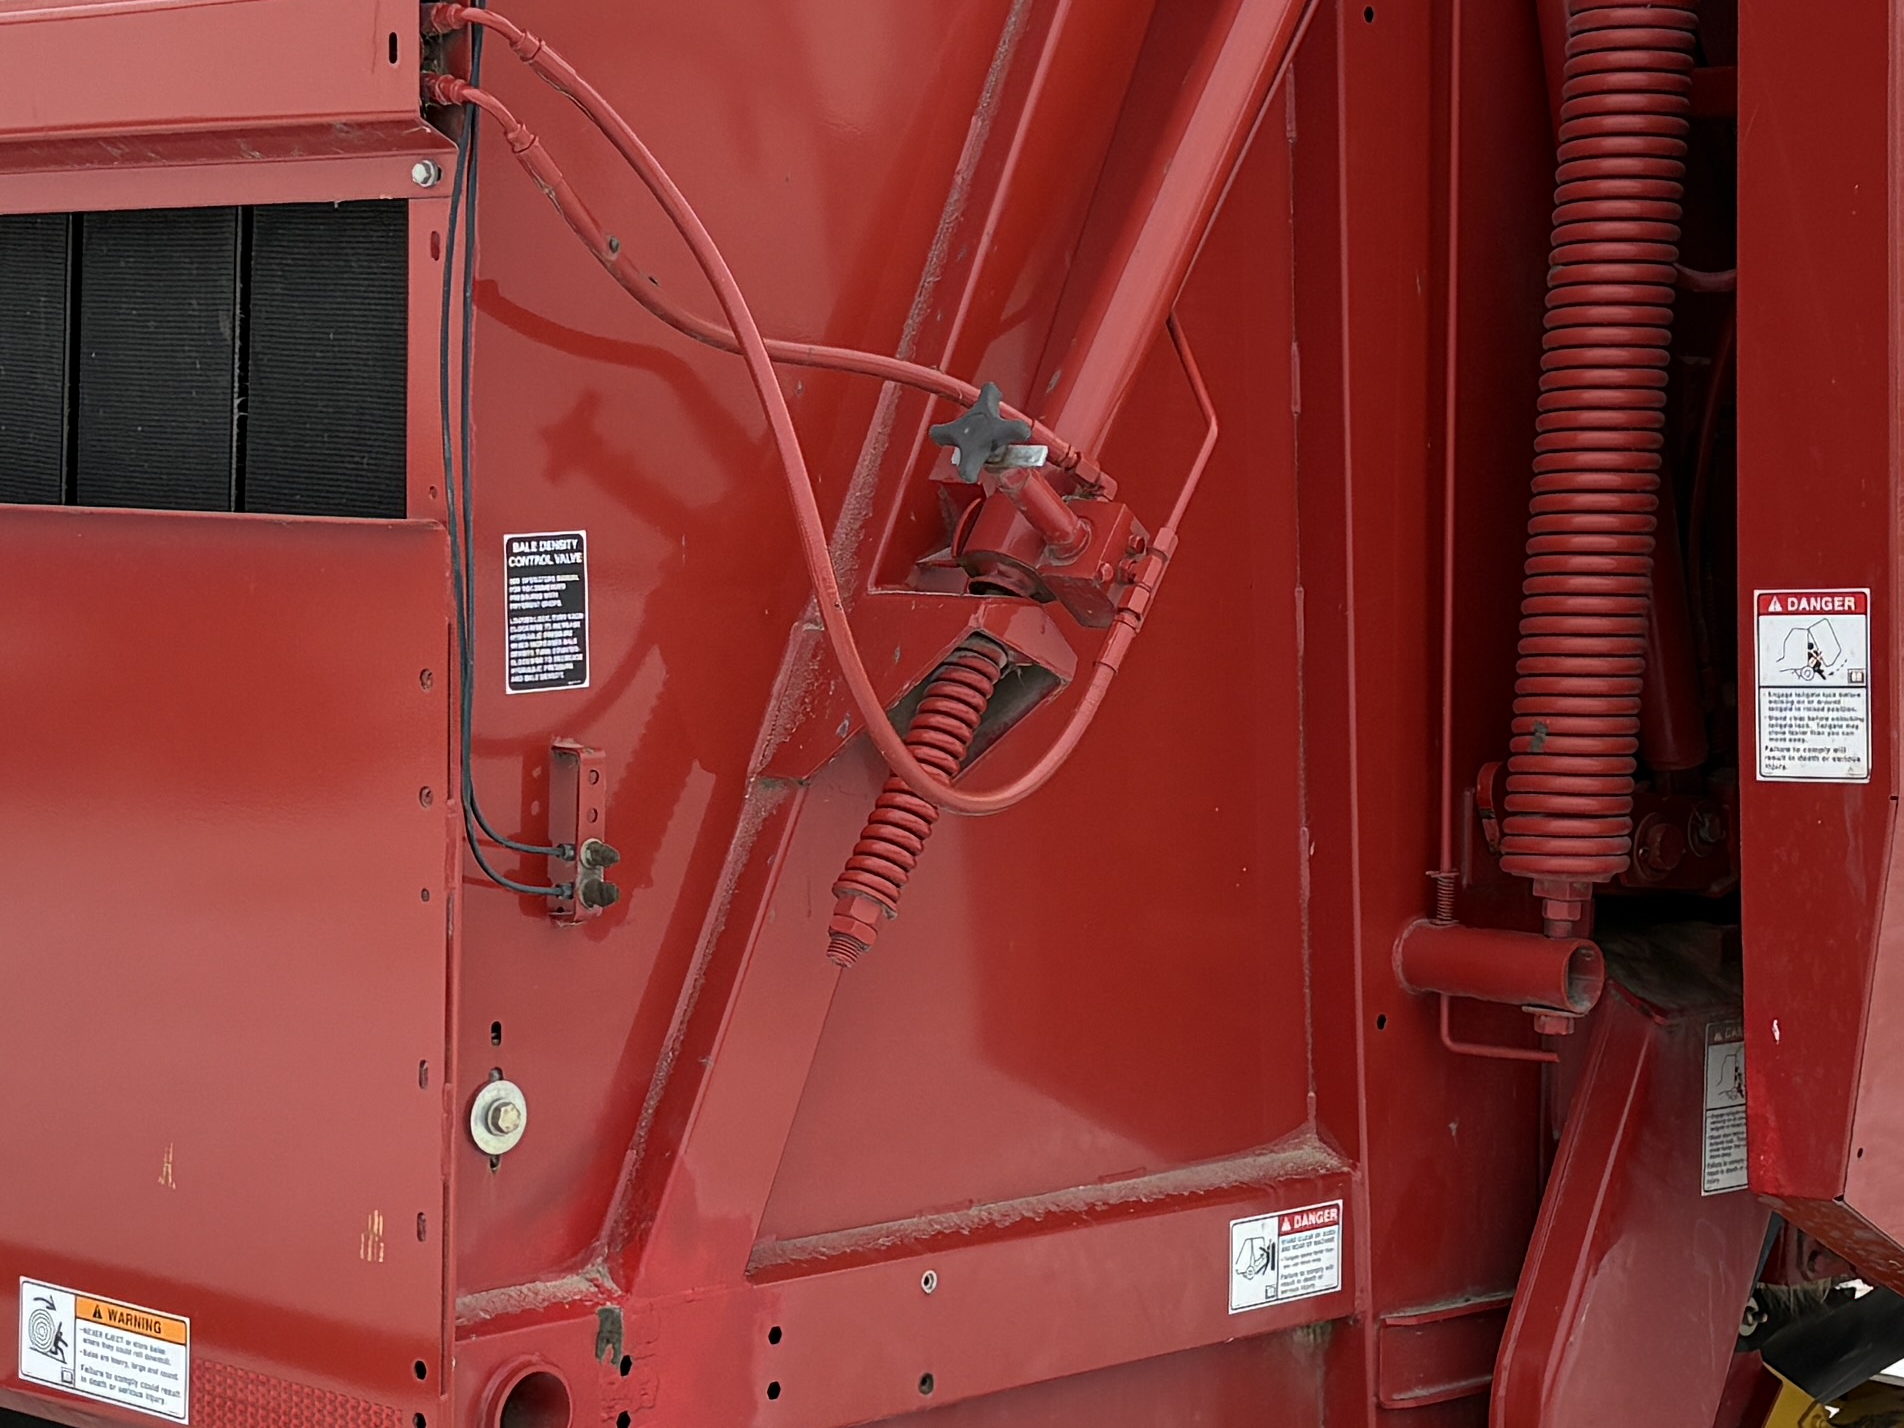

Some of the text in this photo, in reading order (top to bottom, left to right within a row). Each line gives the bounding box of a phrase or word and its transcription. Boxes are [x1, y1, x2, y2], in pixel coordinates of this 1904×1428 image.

[508, 552, 583, 568] CONTROL VALVE
[1787, 596, 1856, 612] DANGER
[1293, 1208, 1338, 1229] DANGER
[107, 1308, 162, 1334] WARNING
